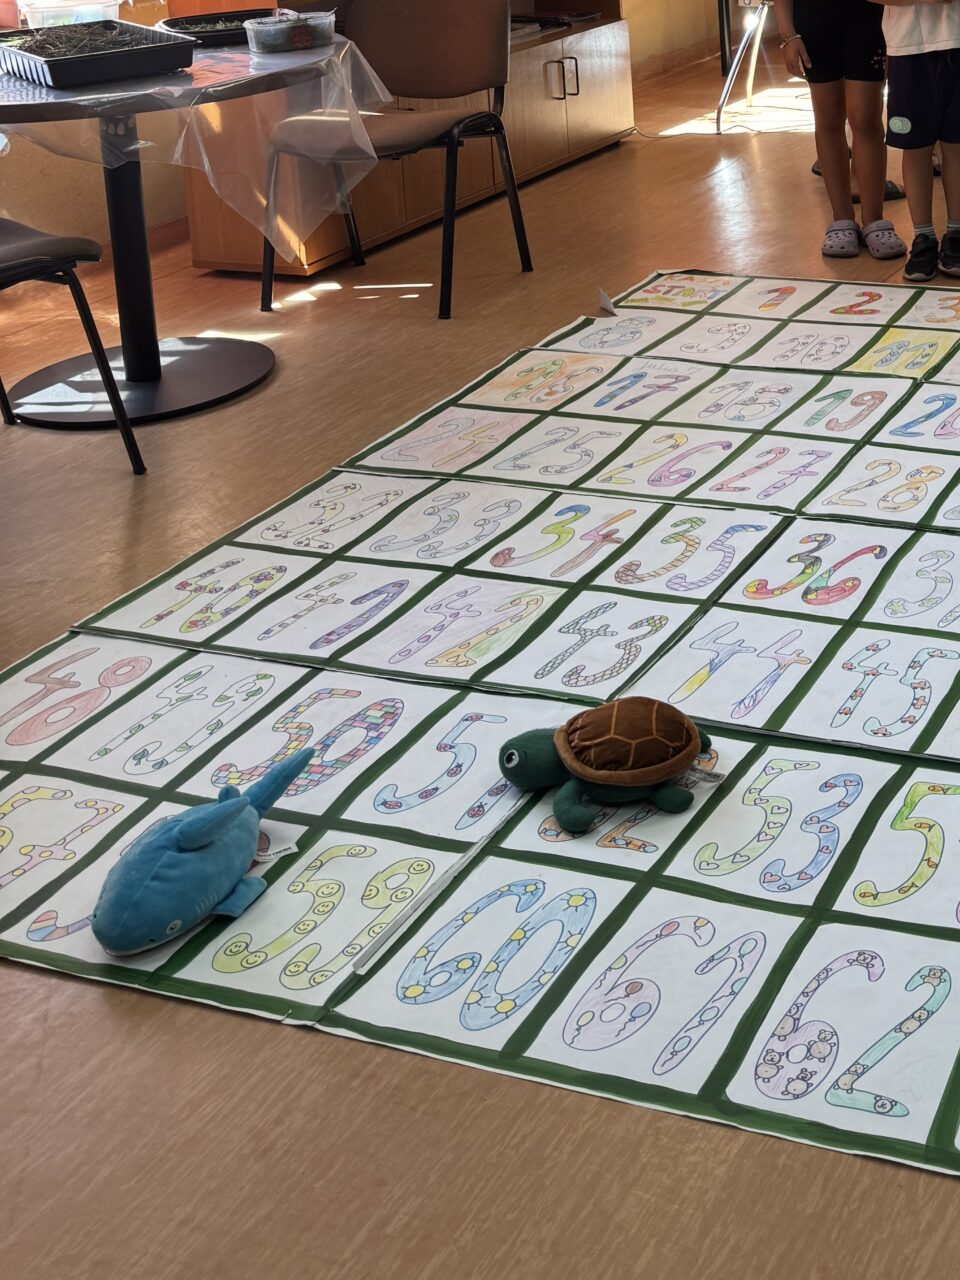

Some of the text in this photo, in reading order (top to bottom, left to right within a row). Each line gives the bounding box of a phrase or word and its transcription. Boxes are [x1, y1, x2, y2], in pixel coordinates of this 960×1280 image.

[578, 316, 656, 350] 8
[759, 286, 796, 311] 1
[830, 291, 883, 315] 2
[680, 323, 752, 354] 9
[873, 340, 939, 369] 11
[503, 358, 604, 403] 16
[593, 371, 692, 411] 17
[804, 388, 887, 432] 19
[380, 418, 500, 467] 24
[492, 426, 623, 475] 25
[597, 433, 733, 488] 26
[709, 446, 834, 501] 27
[260, 482, 404, 551] 32
[820, 458, 945, 513] 28
[369, 492, 522, 560] 33
[489, 504, 637, 578] 34
[614, 517, 768, 591] 35
[139, 557, 288, 634] 40
[741, 533, 888, 606] 36
[256, 571, 410, 650] 41
[388, 585, 544, 668] 42
[534, 600, 670, 687] 43
[0, 647, 153, 746] 48
[667, 621, 812, 719] 44
[830, 638, 960, 738] 45
[89, 664, 276, 775] 49
[210, 687, 405, 798] 50
[693, 759, 864, 893] 53
[211, 843, 435, 990] 59
[396, 879, 597, 1032] 60
[562, 916, 767, 1076] 61
[754, 949, 952, 1118] 62
